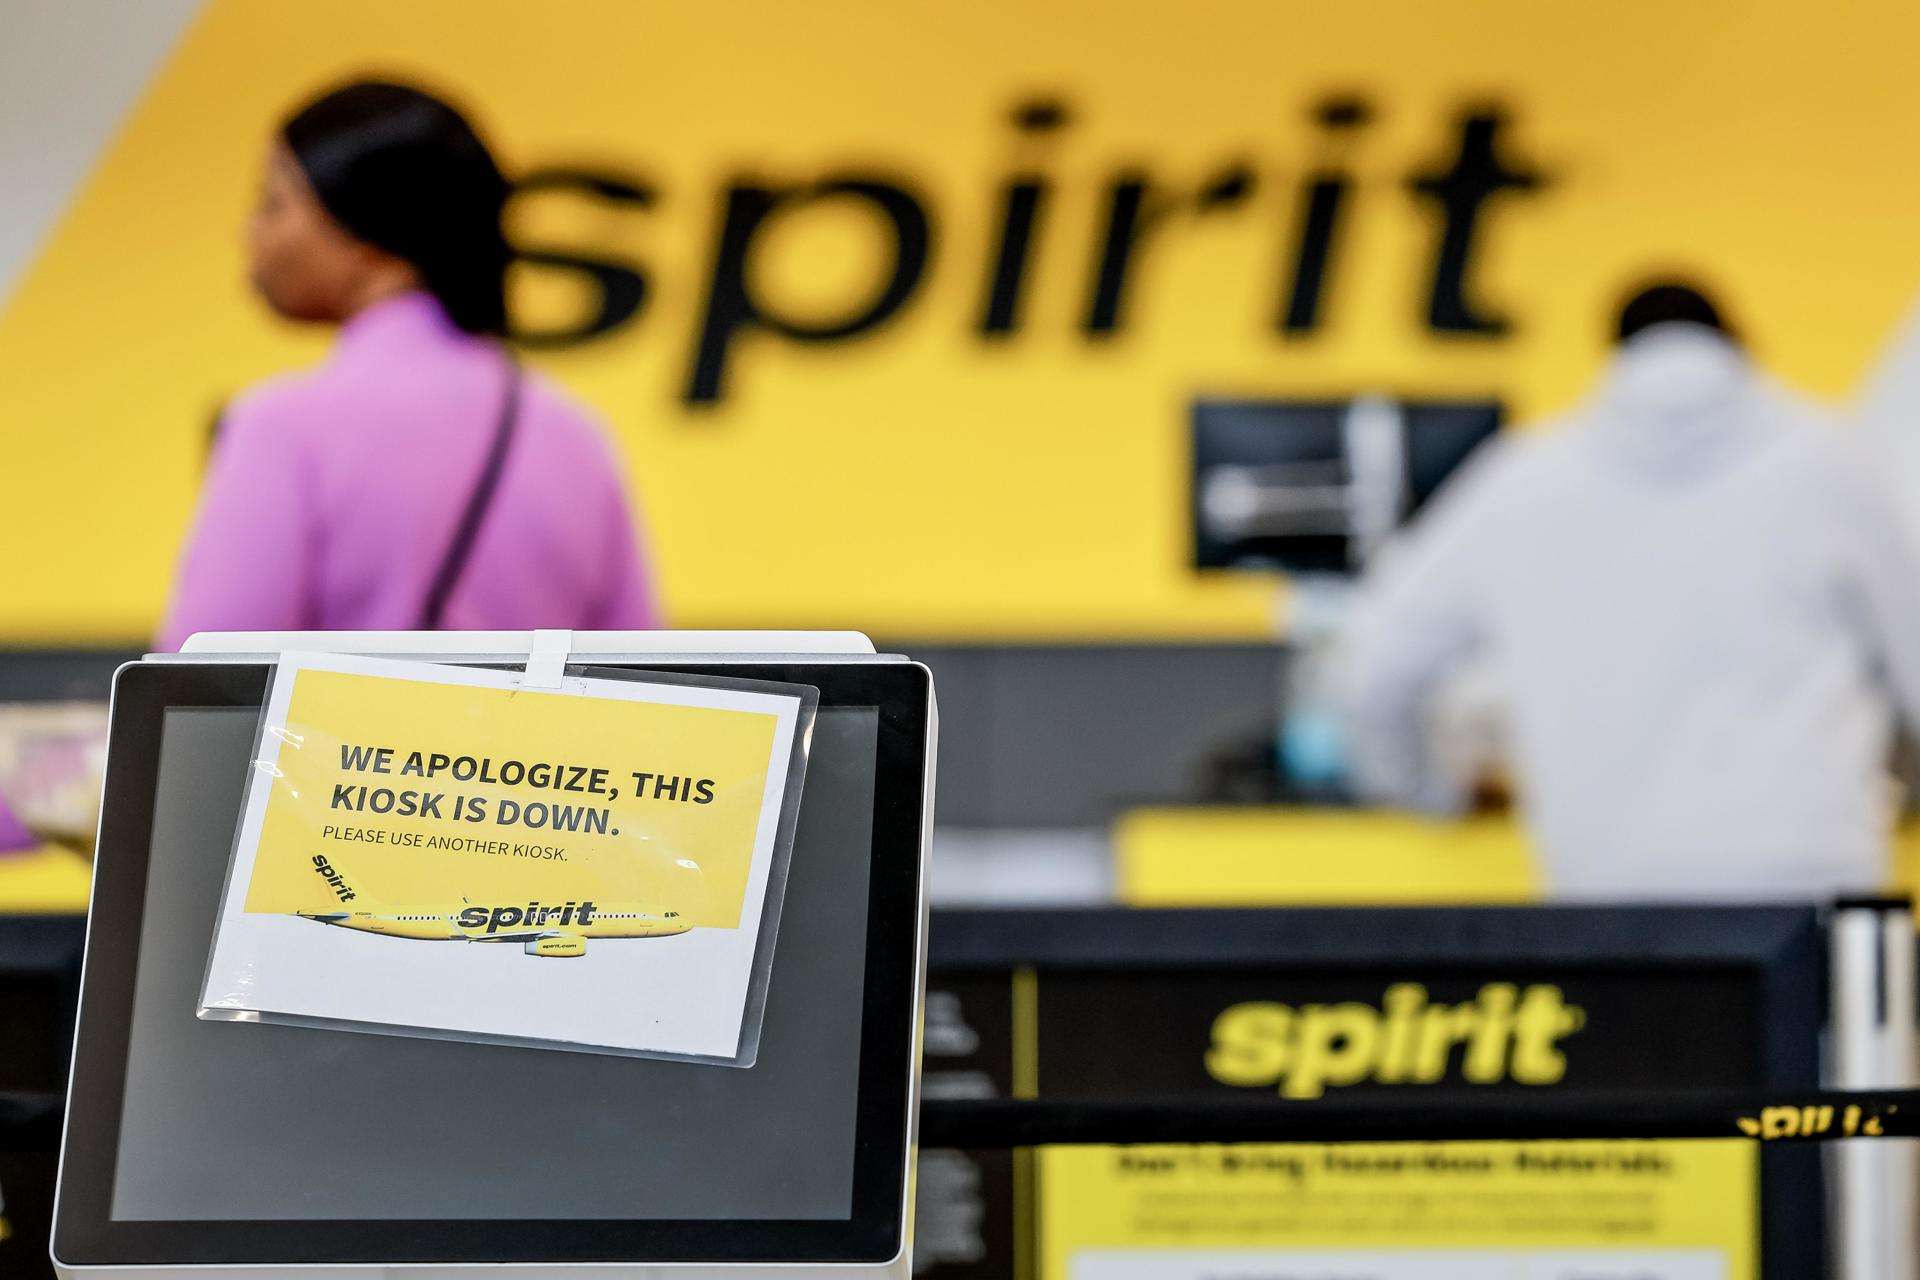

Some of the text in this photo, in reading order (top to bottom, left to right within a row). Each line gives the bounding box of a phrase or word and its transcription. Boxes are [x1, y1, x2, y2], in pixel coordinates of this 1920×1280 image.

[504, 95, 1556, 408] spirit
[340, 744, 716, 805] WE APOLOGIZE, THIS
[330, 784, 621, 837] KIOSK IS DOWN.
[322, 824, 568, 862] PLEASE USE ANOTHER KIOSK.
[311, 853, 356, 905] spirit
[457, 901, 600, 934] spirit
[1205, 982, 1586, 1099] spirit
